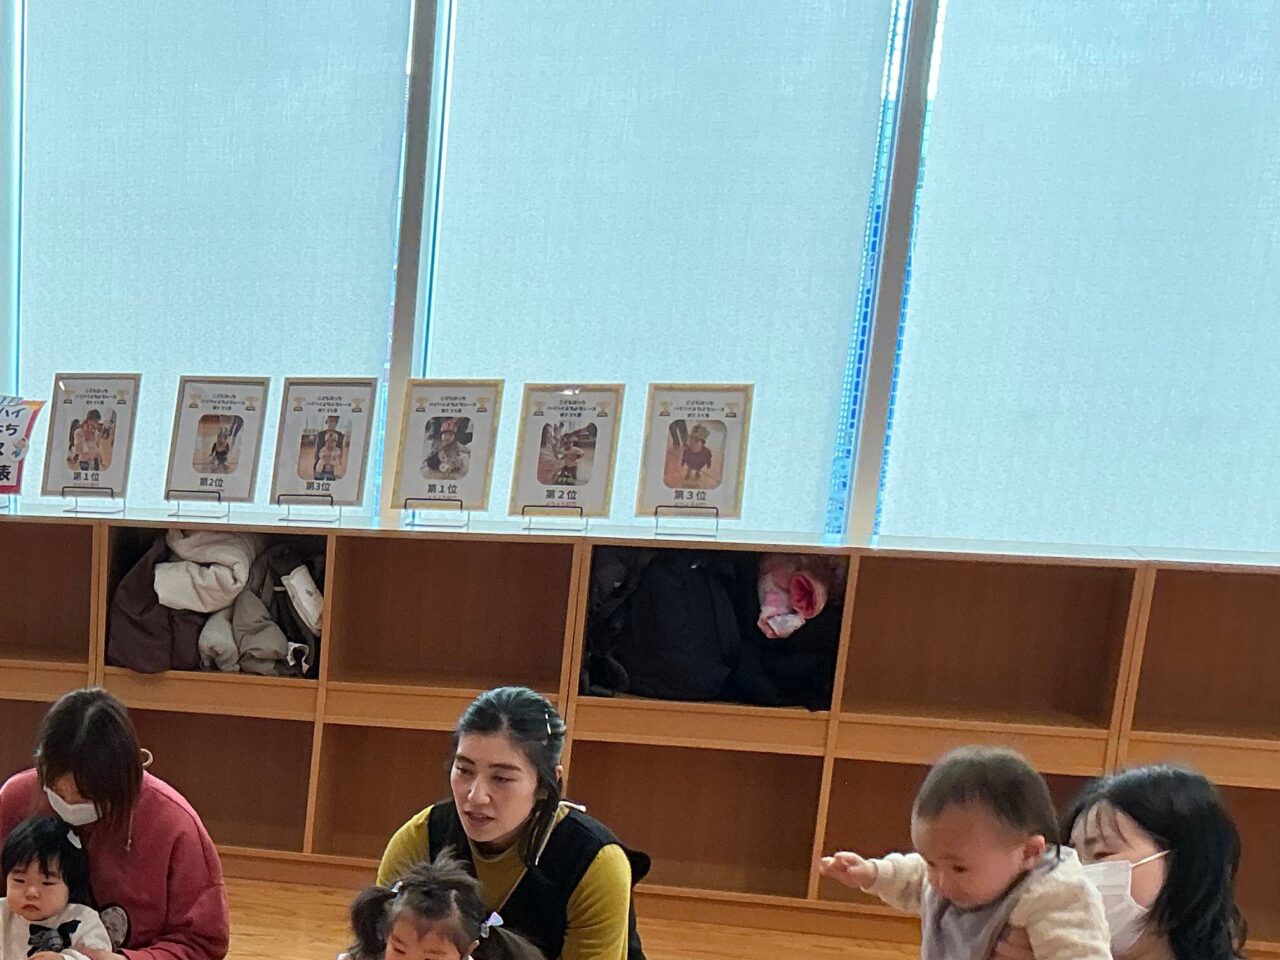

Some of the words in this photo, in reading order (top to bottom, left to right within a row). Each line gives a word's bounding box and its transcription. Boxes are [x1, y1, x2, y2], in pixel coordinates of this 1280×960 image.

[73, 472, 100, 481] 第1位
[200, 477, 224, 487] 第2位
[306, 481, 332, 492] 第3位
[427, 484, 458, 494] 第1位
[545, 490, 578, 500] 第2位
[674, 490, 708, 501] 第3位
